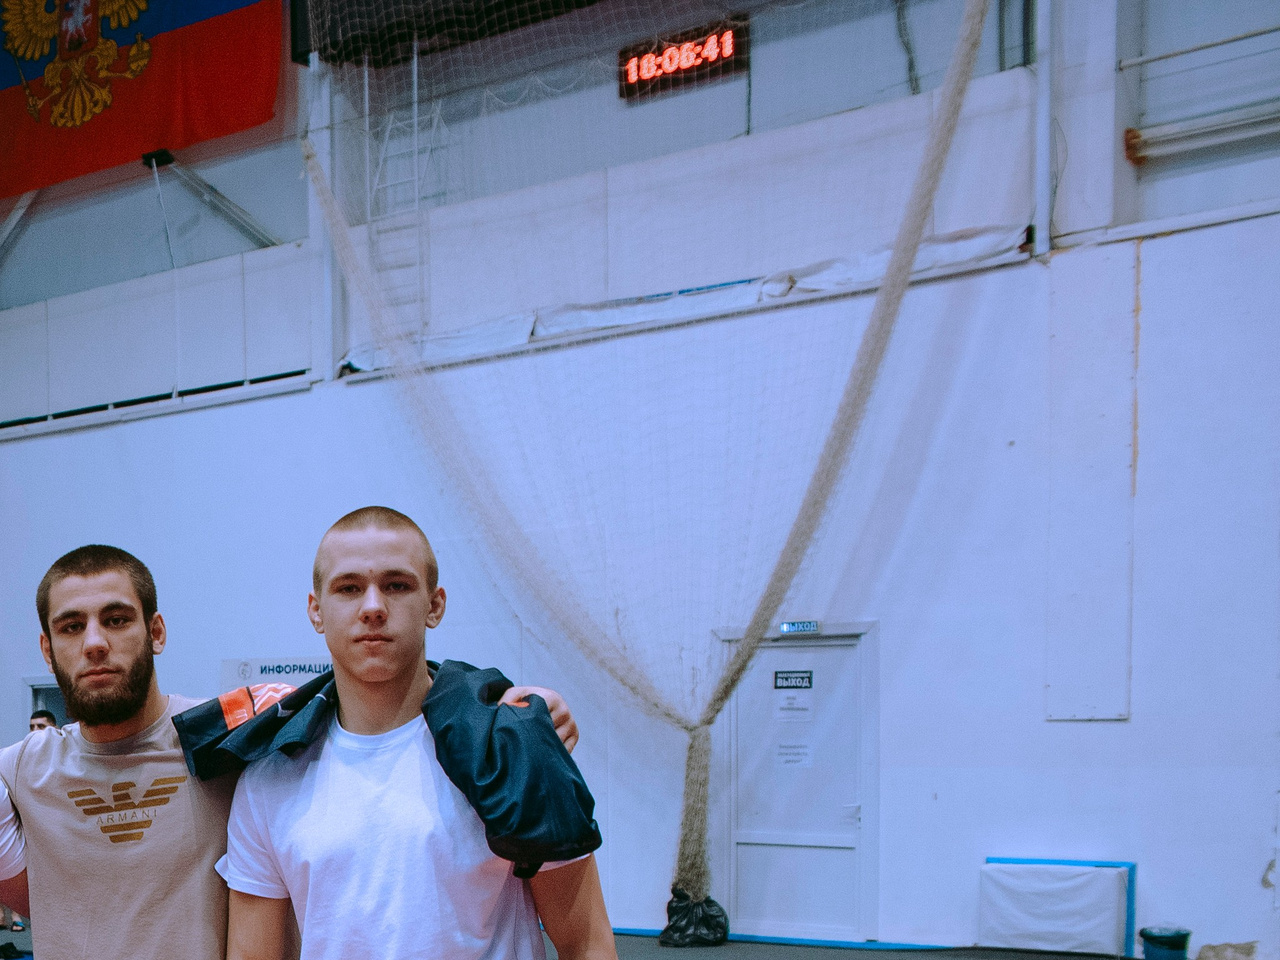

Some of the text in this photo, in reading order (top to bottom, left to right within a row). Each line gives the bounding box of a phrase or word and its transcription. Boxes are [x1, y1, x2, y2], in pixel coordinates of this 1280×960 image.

[626, 30, 734, 84] 18:06:41
[783, 621, 818, 632] ВЫХОД
[776, 677, 811, 687] ВЫХОД
[96, 808, 158, 826] ARMANI
